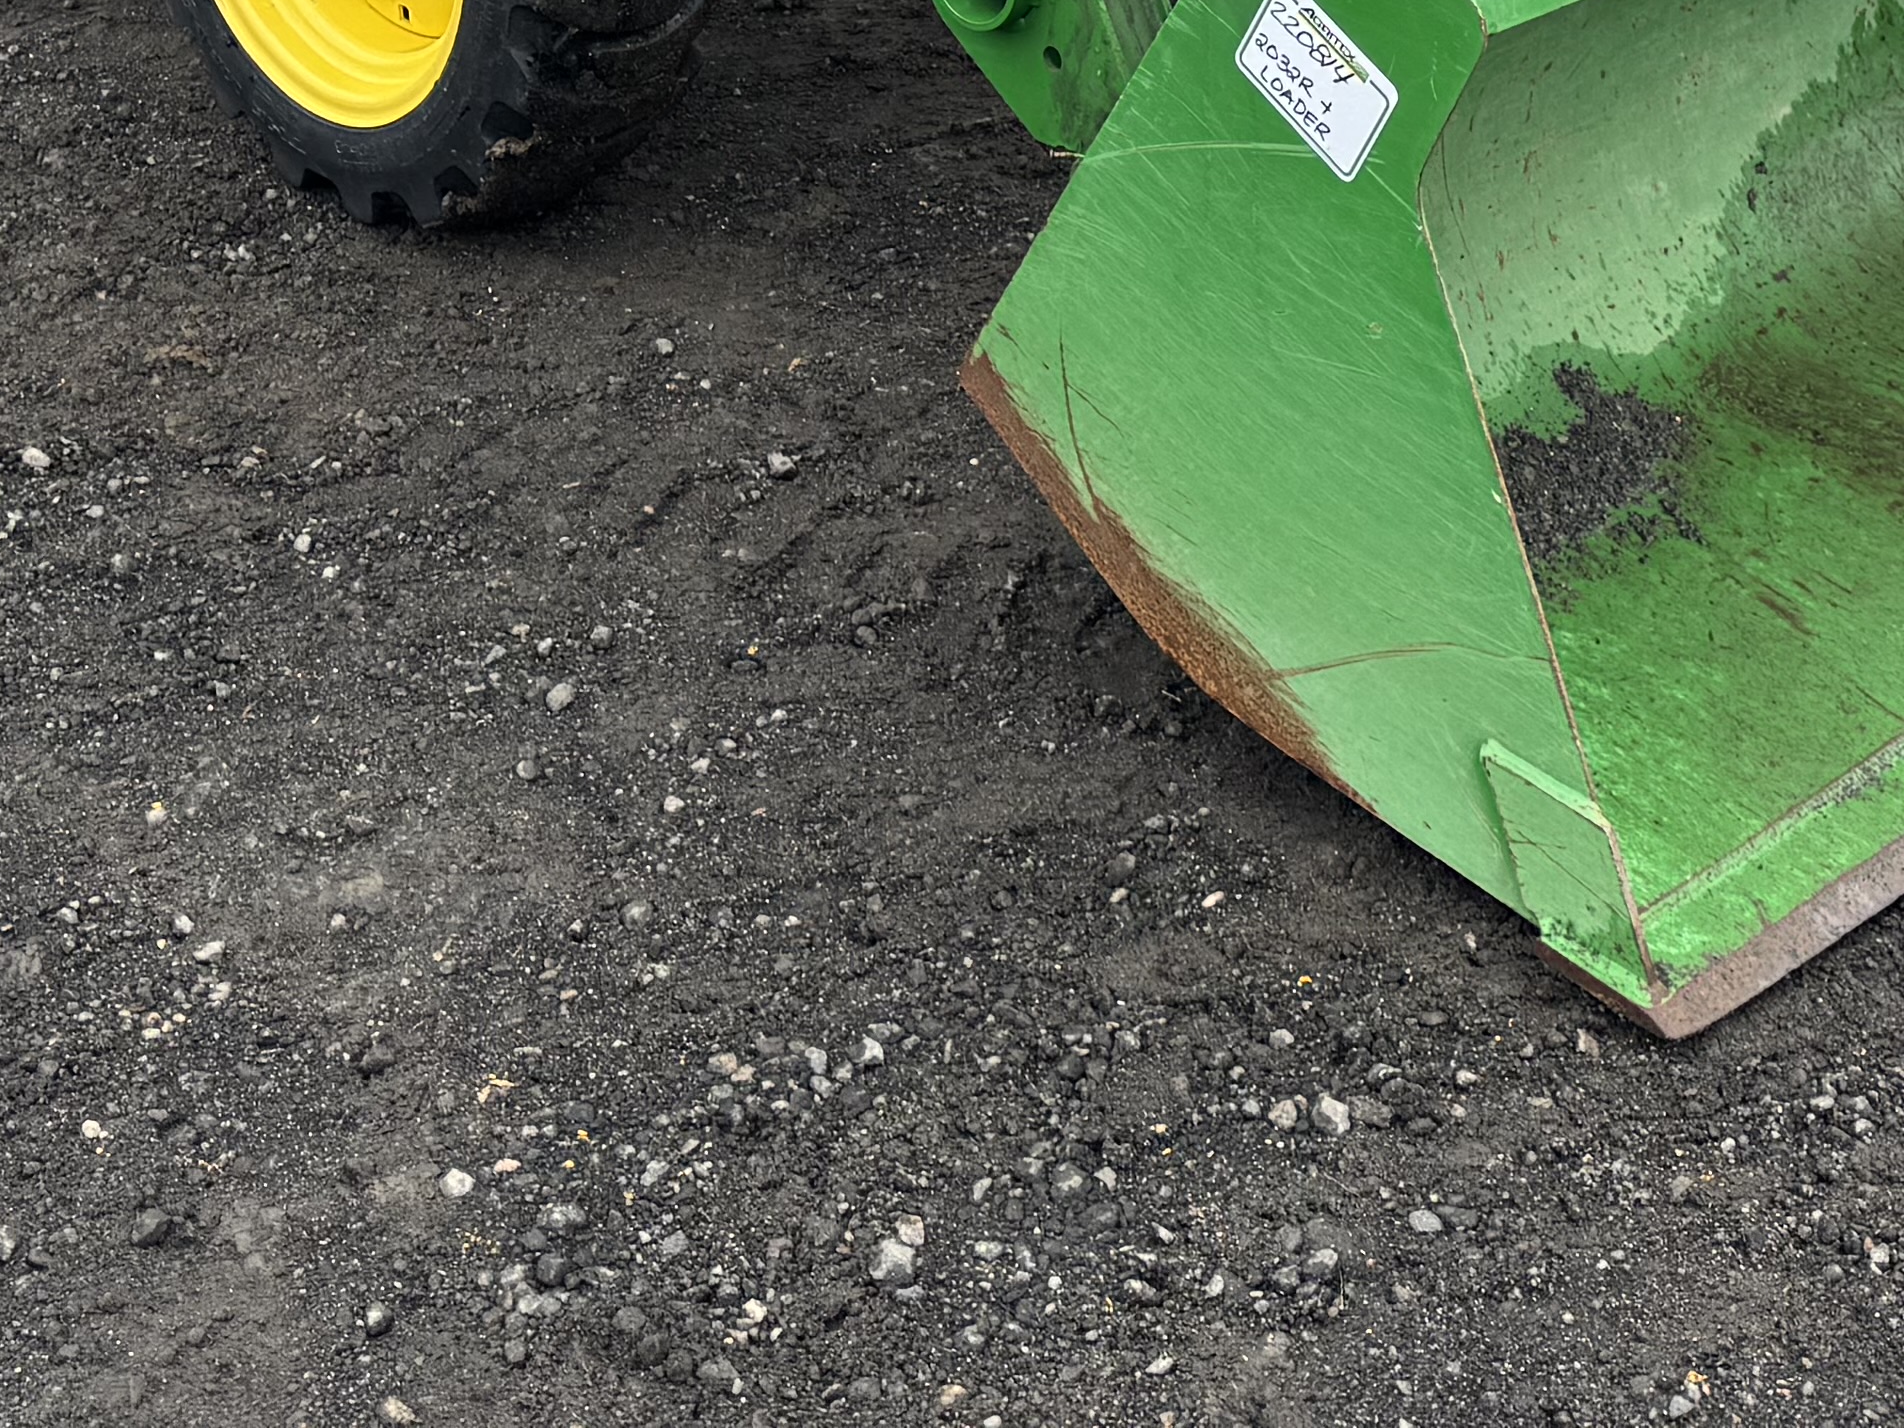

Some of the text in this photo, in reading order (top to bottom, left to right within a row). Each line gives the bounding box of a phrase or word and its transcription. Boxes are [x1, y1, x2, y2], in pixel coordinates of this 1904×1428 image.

[1255, 32, 1314, 98] 2032R
[1270, 1, 1355, 85] 220814
[1260, 65, 1332, 142] LOADER
